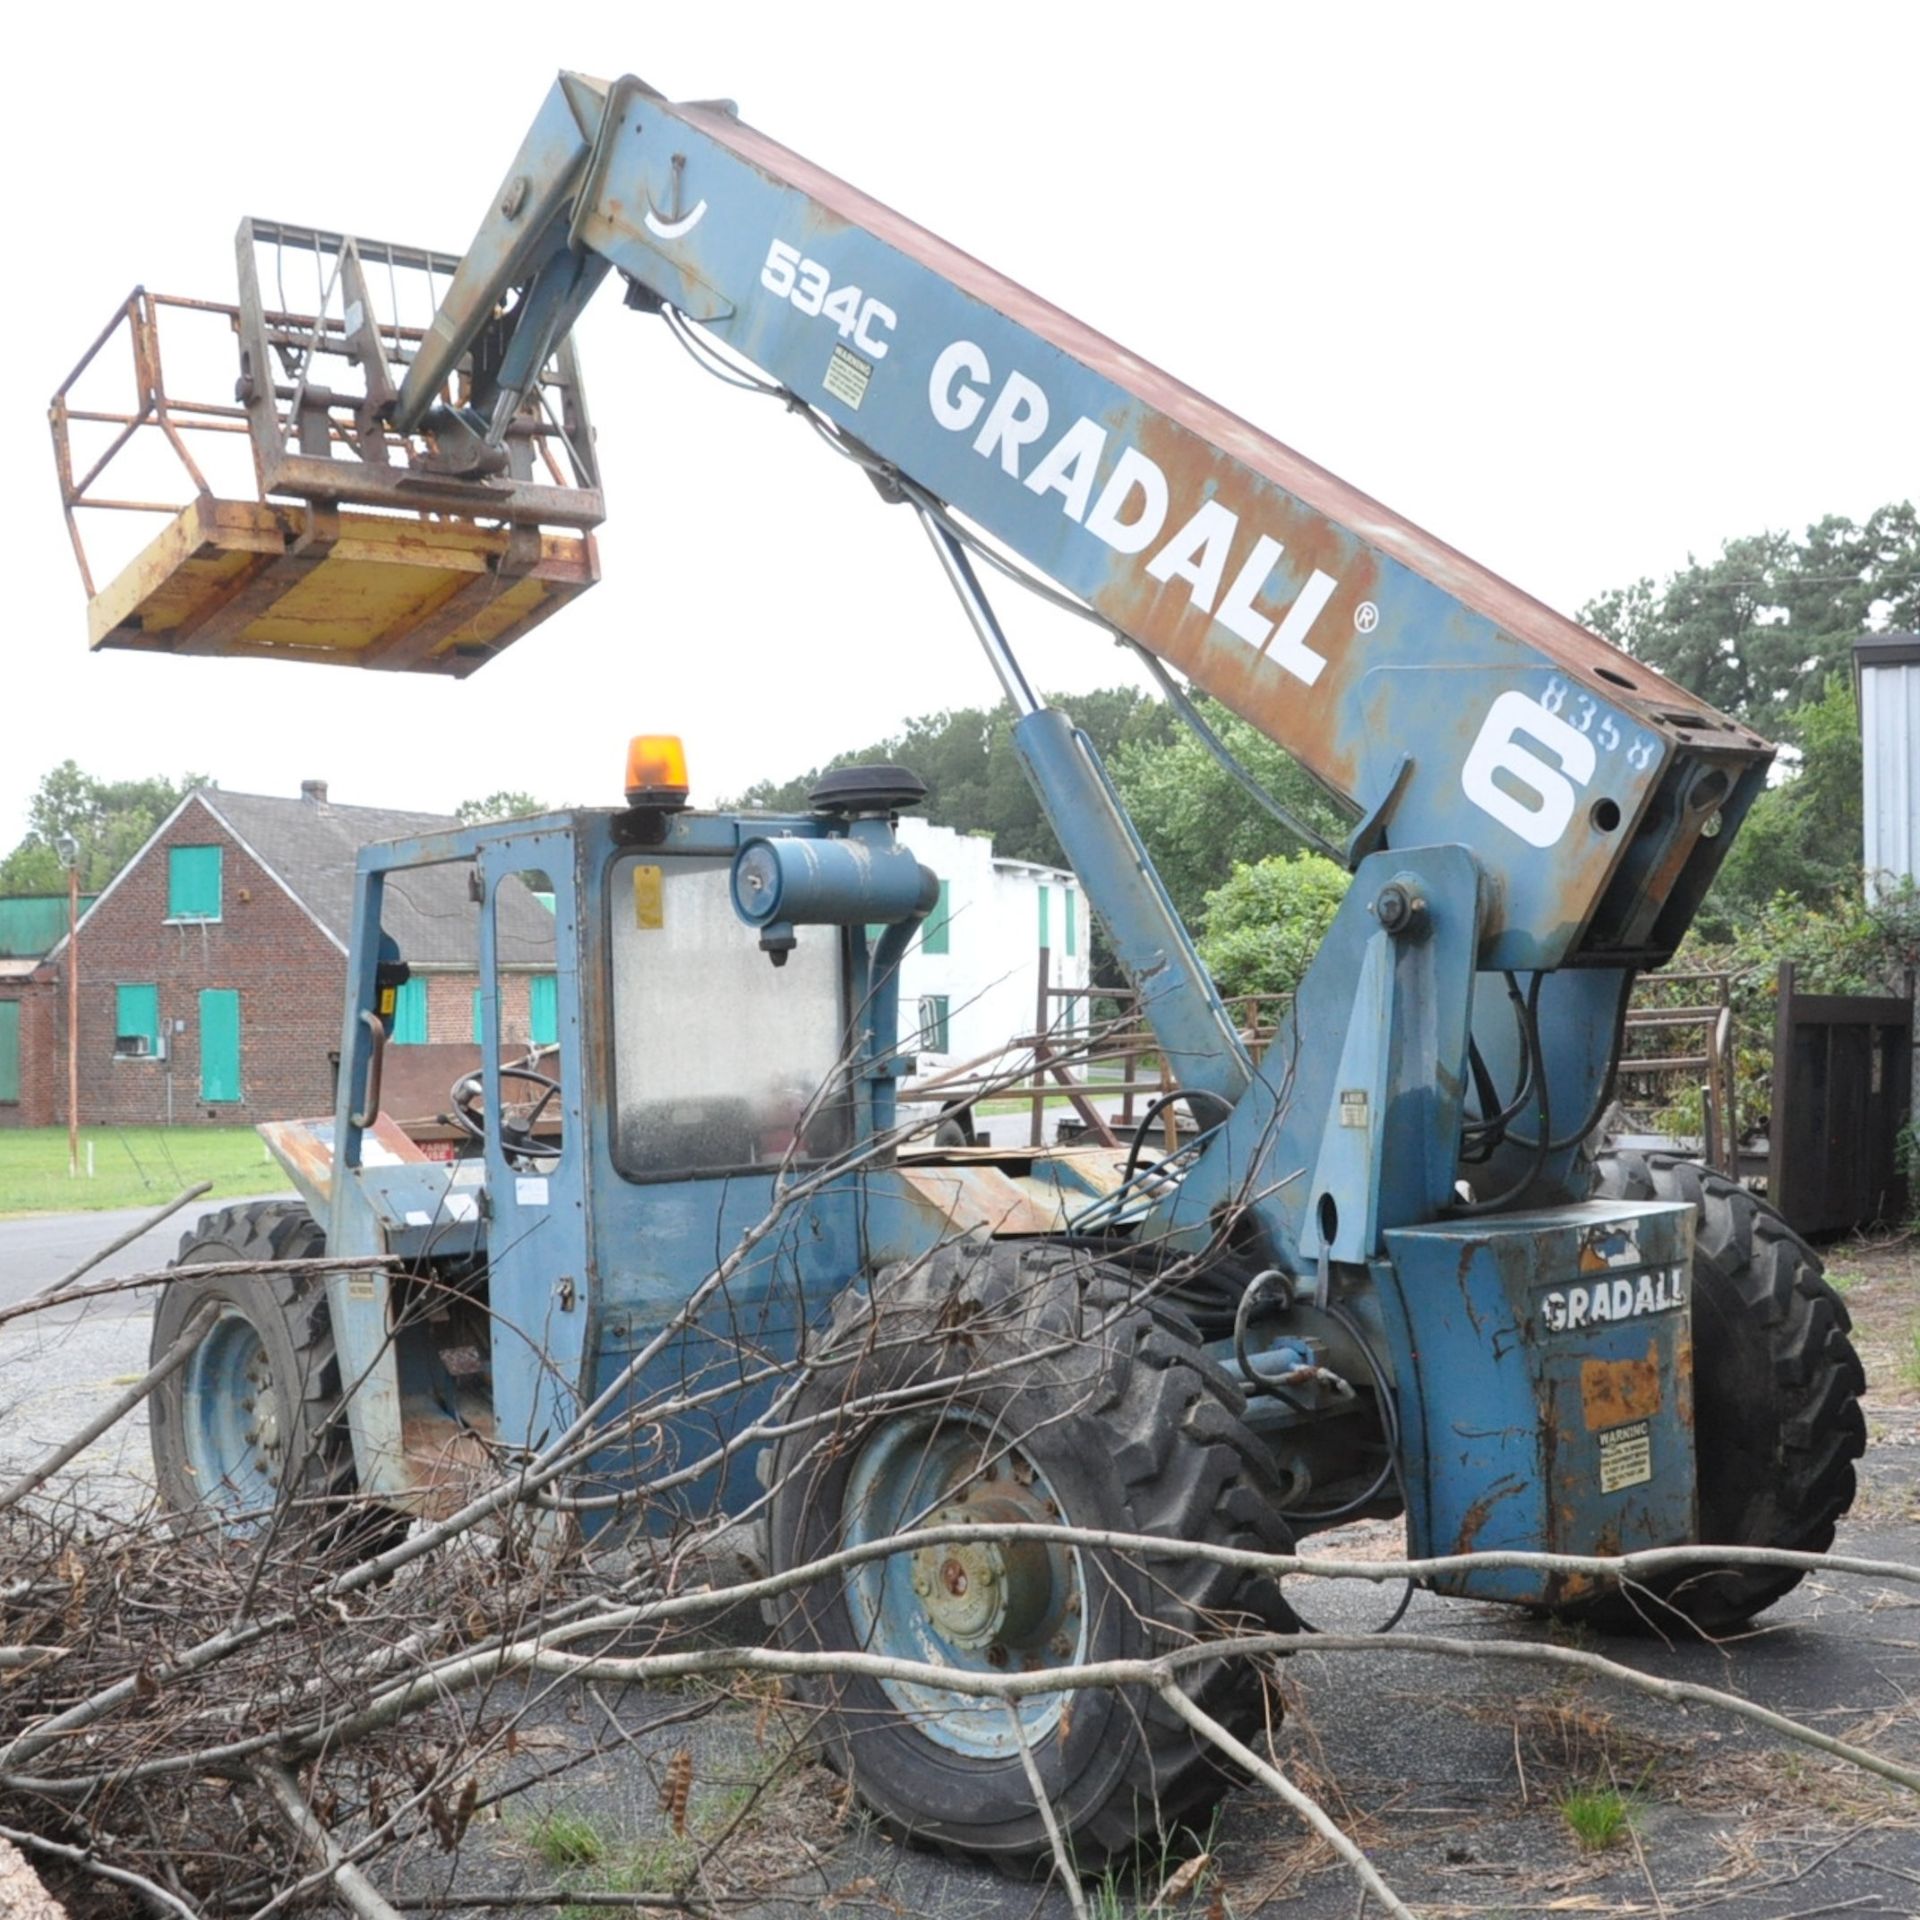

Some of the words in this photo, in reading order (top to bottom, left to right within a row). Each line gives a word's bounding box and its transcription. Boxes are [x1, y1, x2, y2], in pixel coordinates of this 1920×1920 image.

[761, 239, 897, 360] 534C
[928, 340, 1339, 687] GRADALL
[1461, 690, 1597, 849] 6
[1540, 676, 1656, 771] 8358
[1541, 1268, 1687, 1332] GRADALL
[1599, 1421, 1649, 1446] WARNING
